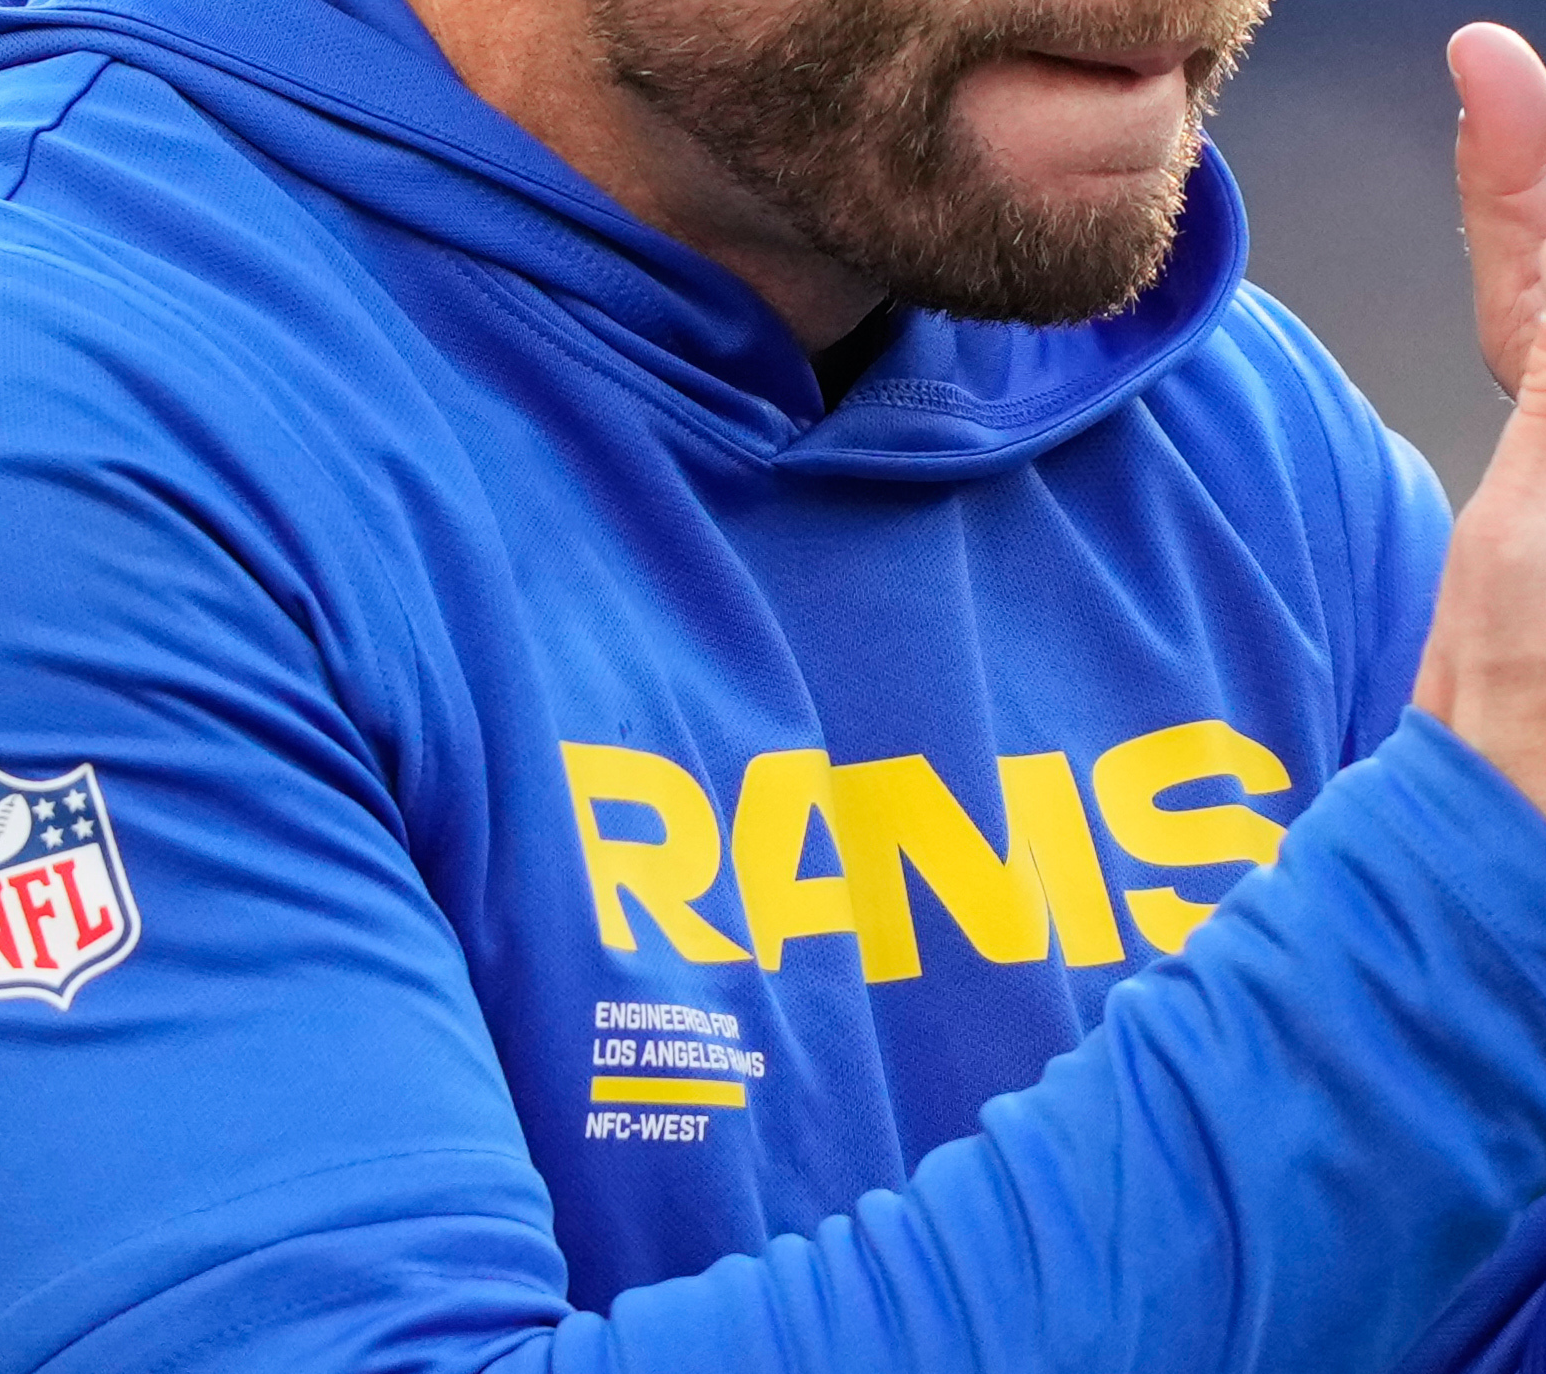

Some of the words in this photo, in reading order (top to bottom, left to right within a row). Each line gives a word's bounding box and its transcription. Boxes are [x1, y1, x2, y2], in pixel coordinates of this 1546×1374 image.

[560, 720, 1292, 983] RAMS
[595, 1001, 711, 1035] ENGINEERED
[709, 1012, 740, 1039] FOR
[593, 1038, 636, 1066] LOS
[640, 1040, 729, 1070] ANGELES
[585, 1112, 709, 1141] NFC-WEST
